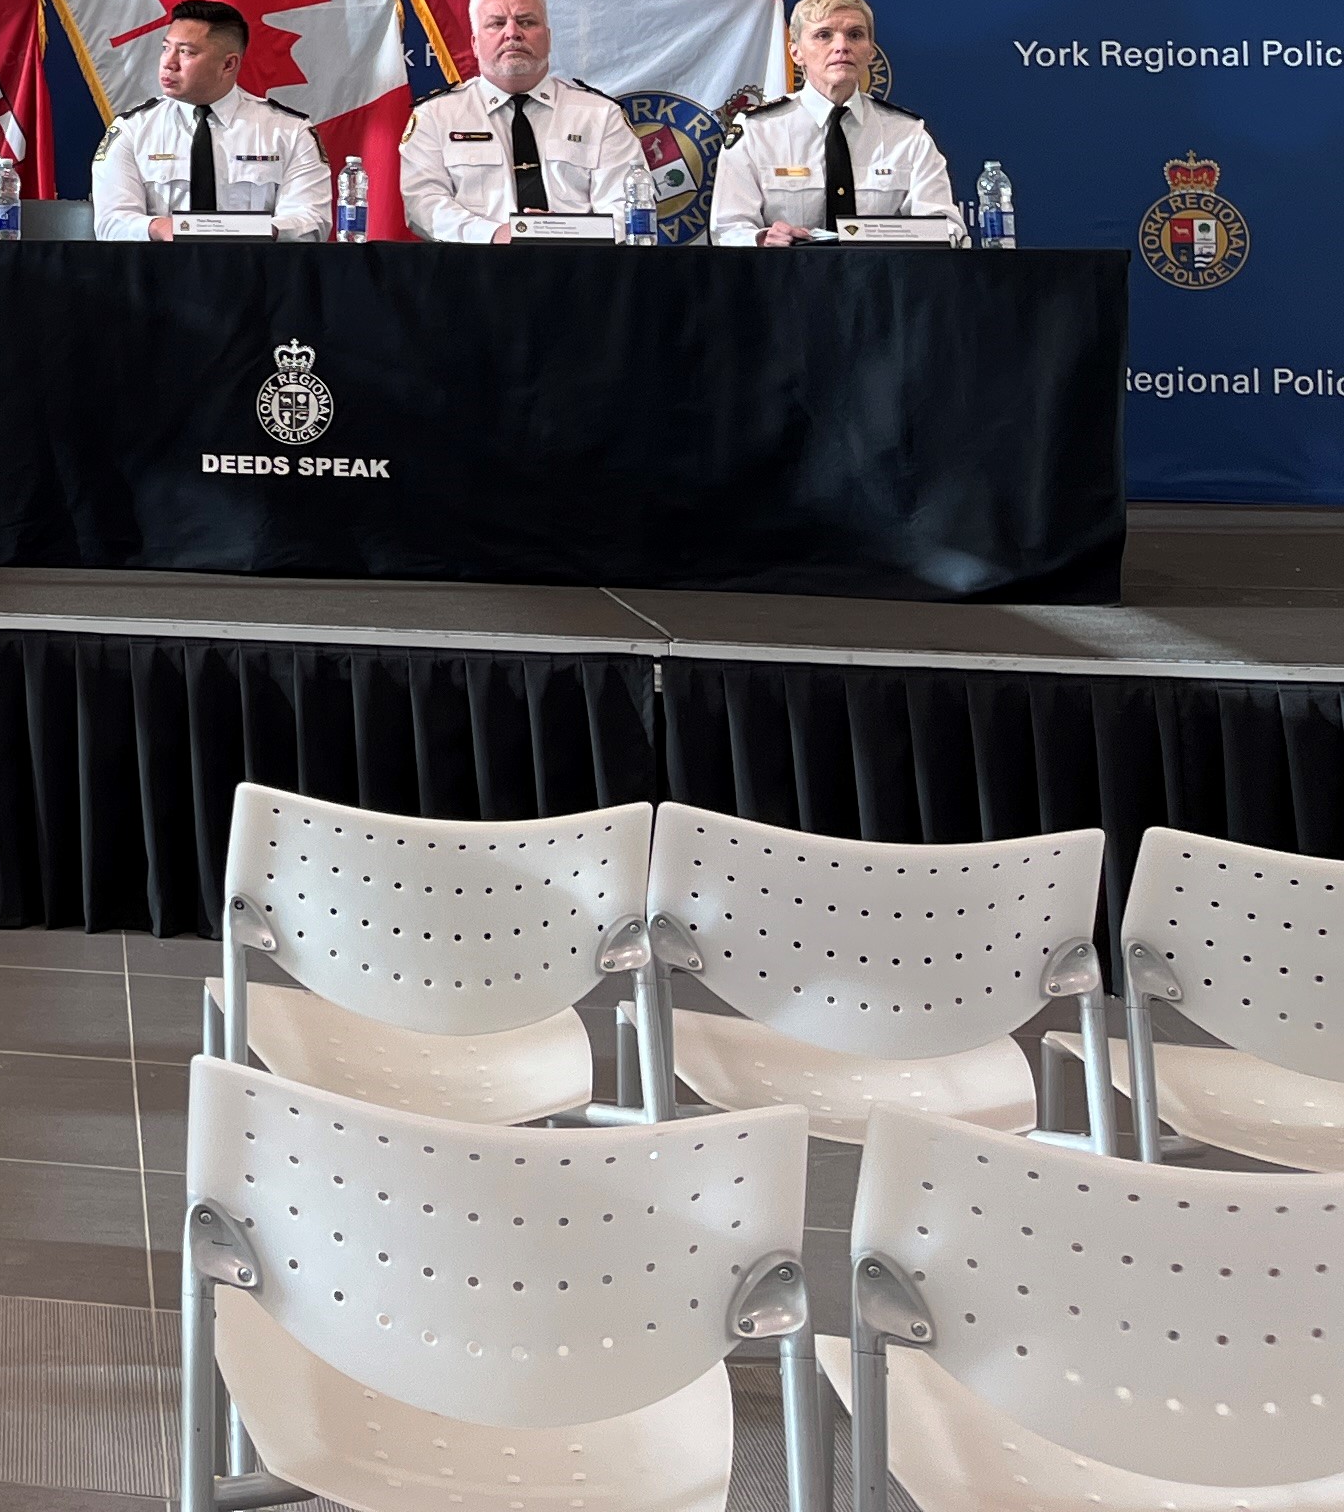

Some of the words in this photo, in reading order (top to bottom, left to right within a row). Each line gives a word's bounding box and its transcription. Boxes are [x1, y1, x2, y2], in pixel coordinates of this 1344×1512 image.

[1014, 41, 1090, 67] York
[1102, 41, 1249, 73] Regional
[1263, 41, 1343, 67] Polic
[1144, 211, 1171, 264] YORK
[1171, 194, 1244, 257] REGIONAL
[1161, 261, 1228, 286] POLICE
[279, 373, 330, 421] REGIONAL
[1274, 369, 1344, 396] Poli
[261, 386, 279, 426] YORK
[272, 424, 318, 442] POLICE
[201, 453, 290, 476] DEEDS
[298, 456, 390, 479] SPEAK
